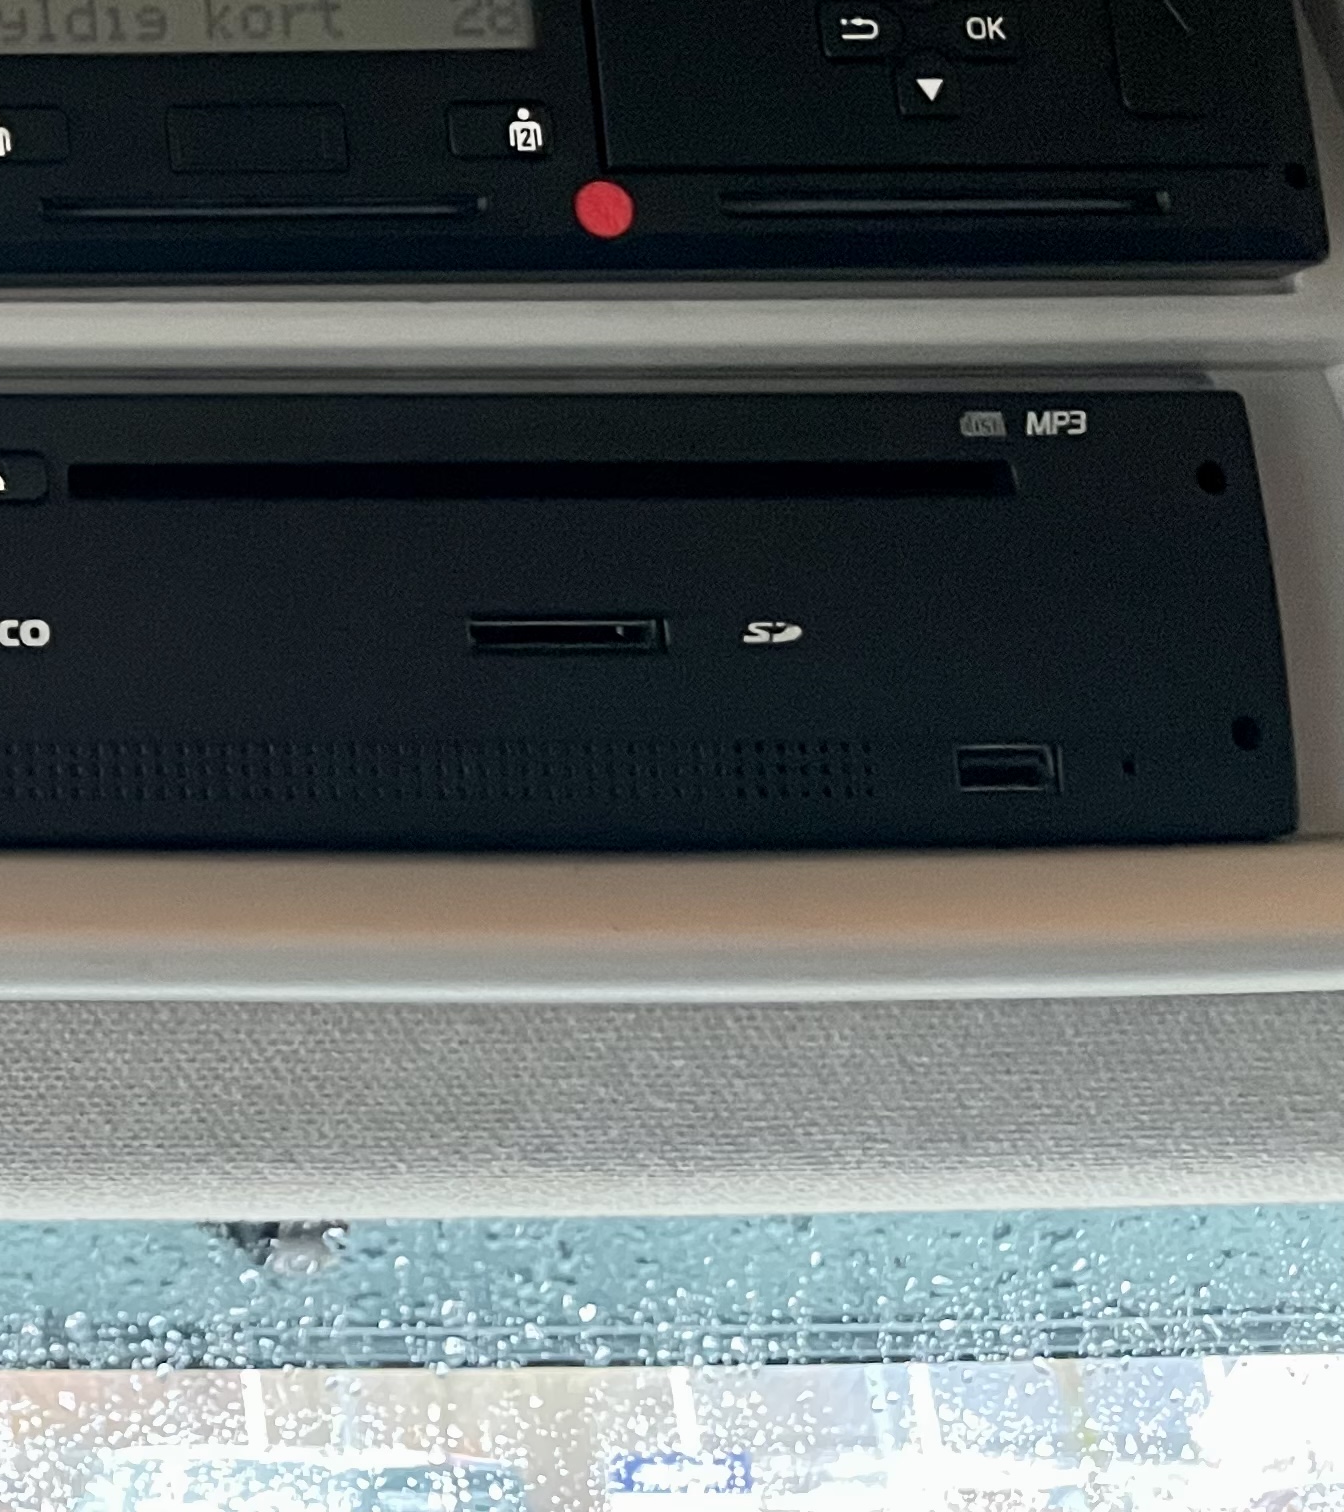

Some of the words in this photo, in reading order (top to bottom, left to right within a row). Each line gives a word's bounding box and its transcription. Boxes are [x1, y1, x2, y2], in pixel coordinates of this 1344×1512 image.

[965, 16, 1006, 42] OK
[1026, 410, 1087, 436] MP3
[743, 621, 803, 643] SD
